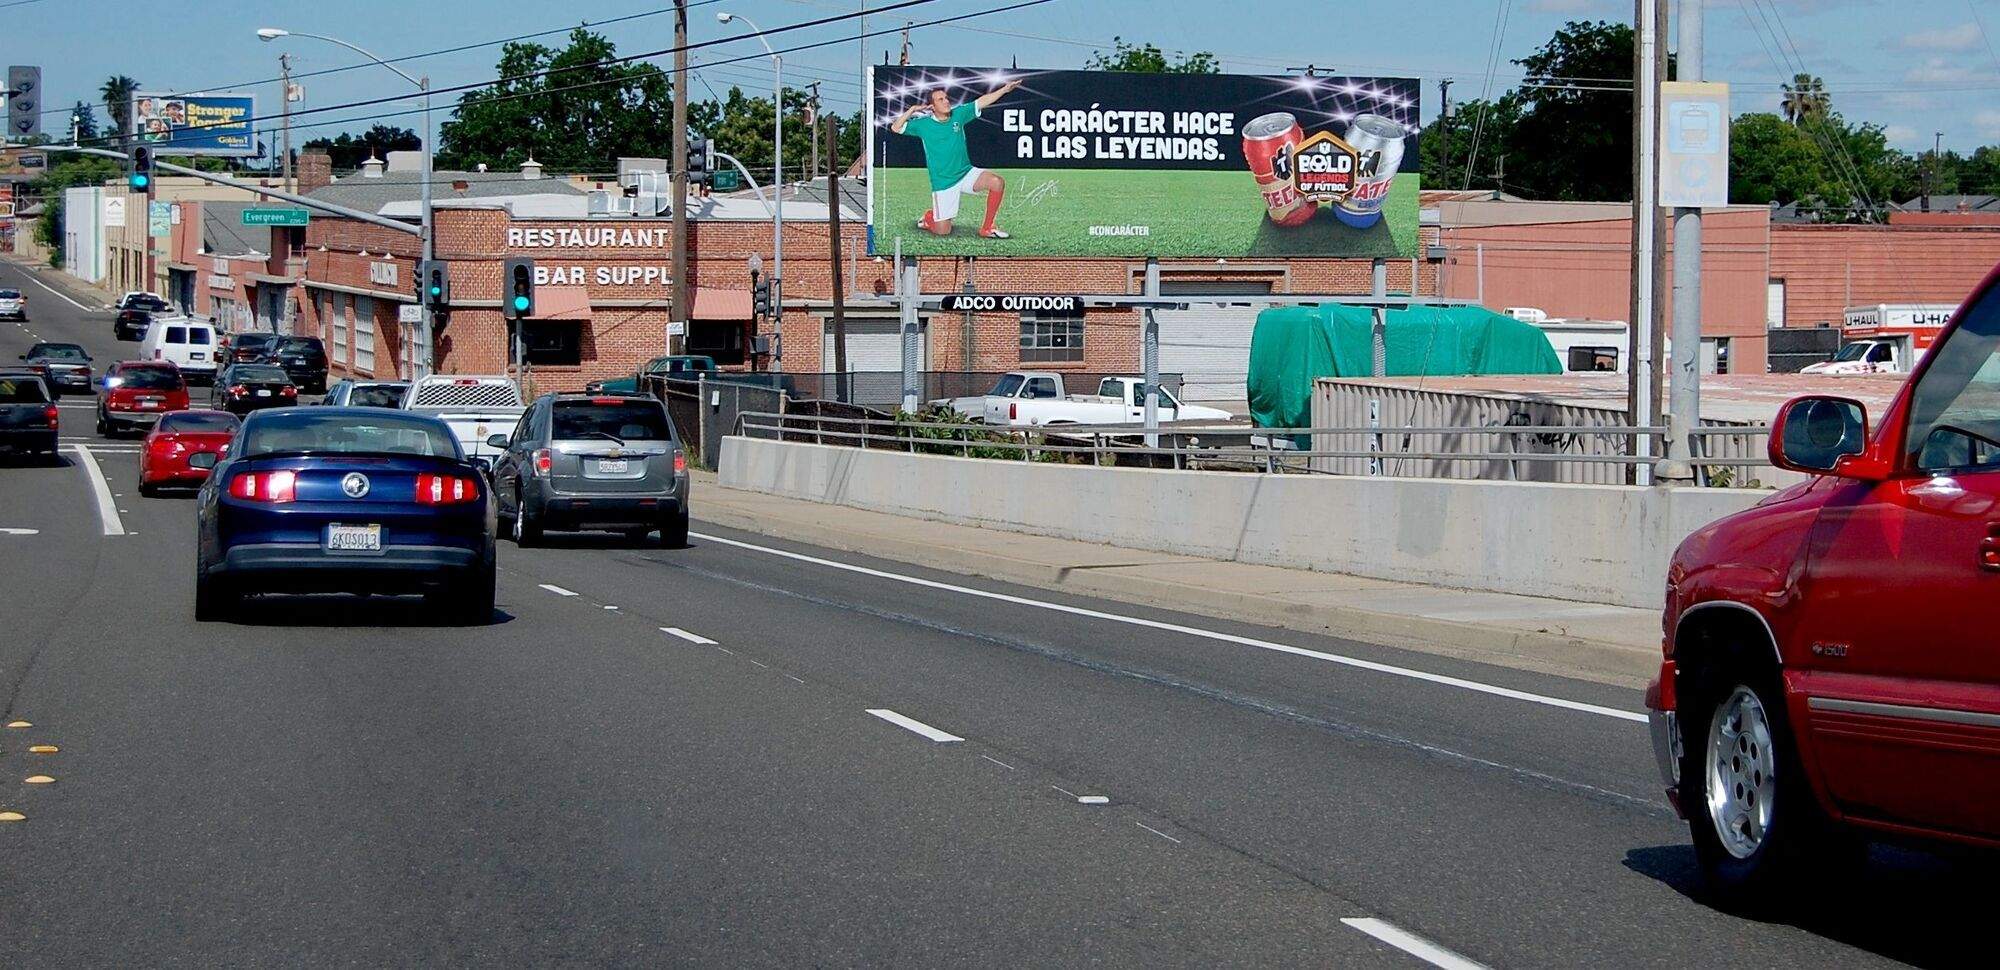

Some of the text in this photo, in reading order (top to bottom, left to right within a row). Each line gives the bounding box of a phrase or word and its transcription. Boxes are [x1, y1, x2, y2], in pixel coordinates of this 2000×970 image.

[188, 103, 245, 119] Stronger
[1003, 103, 1234, 135] EL CARÁCTER HACE
[1017, 135, 1226, 160] A LAS LEYENDAS.
[1300, 173, 1349, 183] LEGENDS
[246, 212, 285, 224] Evergreen
[508, 228, 668, 247] RESTAURANT
[534, 266, 673, 285] BAR SUPPL
[953, 296, 1074, 310] ADCO OUTDOOR
